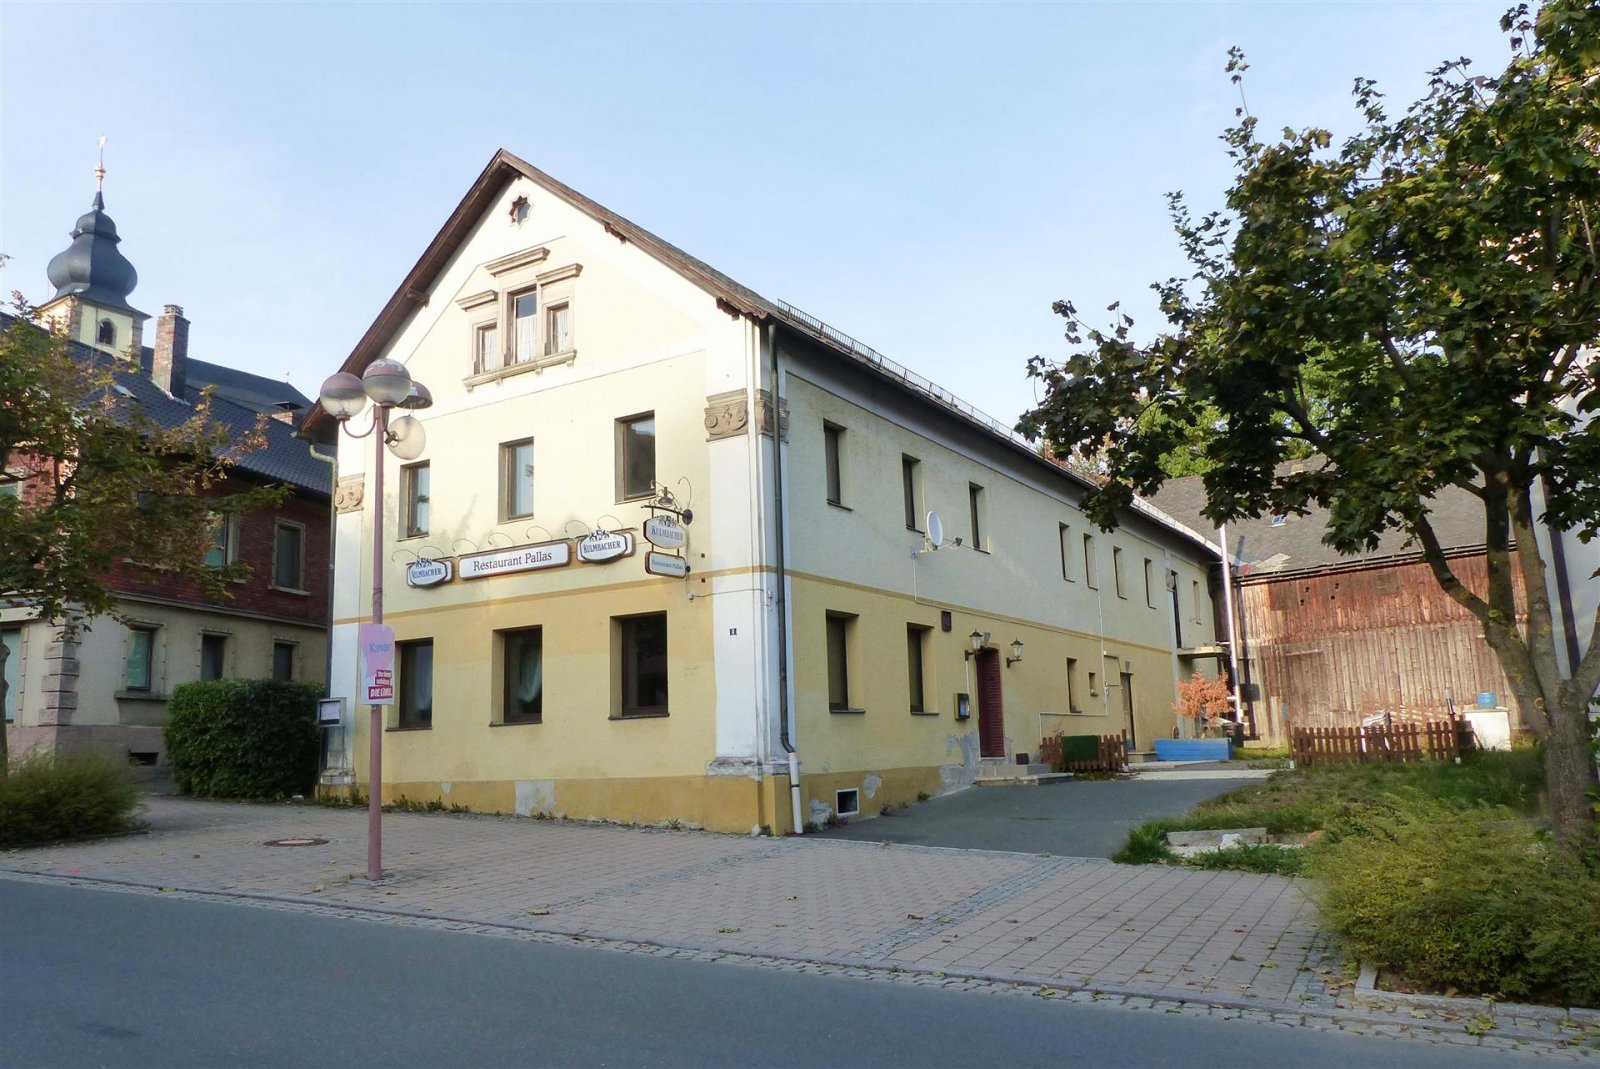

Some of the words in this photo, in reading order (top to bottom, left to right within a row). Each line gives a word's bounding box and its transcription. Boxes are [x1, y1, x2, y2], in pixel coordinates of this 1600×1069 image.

[583, 541, 622, 554] KULMBACHER
[473, 555, 522, 572] Restaurant
[525, 551, 552, 564] Pallas
